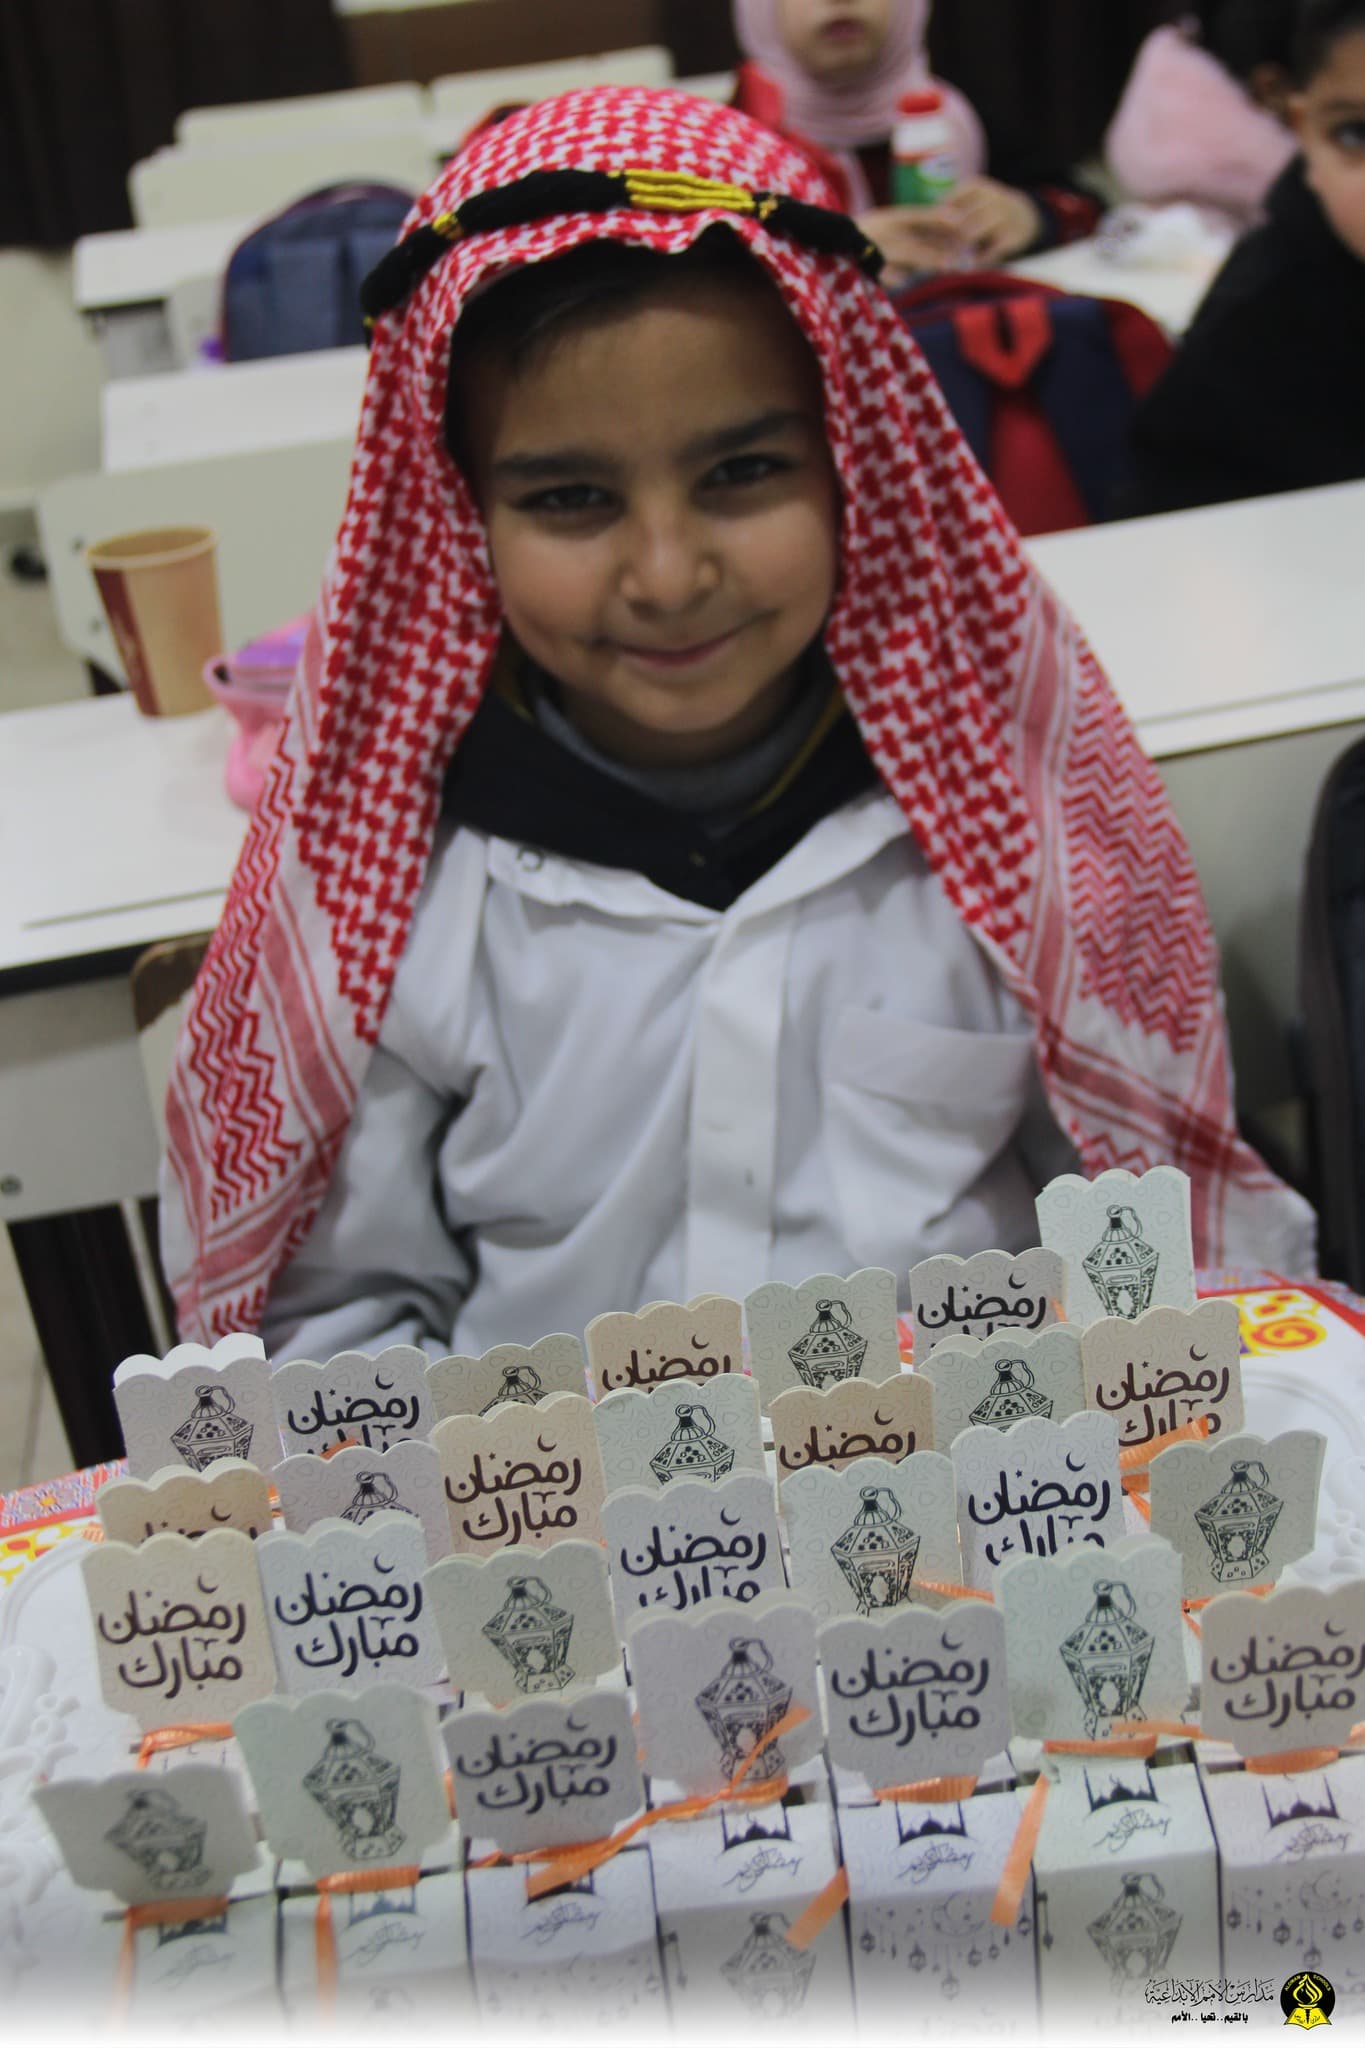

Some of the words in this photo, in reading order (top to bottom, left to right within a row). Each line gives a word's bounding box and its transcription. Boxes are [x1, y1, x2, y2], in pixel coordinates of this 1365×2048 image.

[918, 1286, 1046, 1329] رمضان
[288, 1389, 420, 1435] رمضان
[1096, 1361, 1230, 1411] رمضان
[445, 1452, 582, 1504] رمضان
[968, 1470, 1110, 1525] رمضان
[462, 1491, 577, 1547] مبارك
[621, 1525, 766, 1576] رمضان
[98, 1590, 246, 1645] رمضان
[274, 1572, 423, 1626] رمضان
[118, 1635, 243, 1699] مبارك
[295, 1615, 419, 1677] مبارك
[1211, 1635, 1365, 1684] رمضان
[831, 1648, 989, 1698] رمضان
[849, 1689, 980, 1747] مبارك
[1225, 1674, 1356, 1729] مبارك
[457, 1732, 617, 1778] رمضان
[476, 1765, 610, 1815] مبارك
